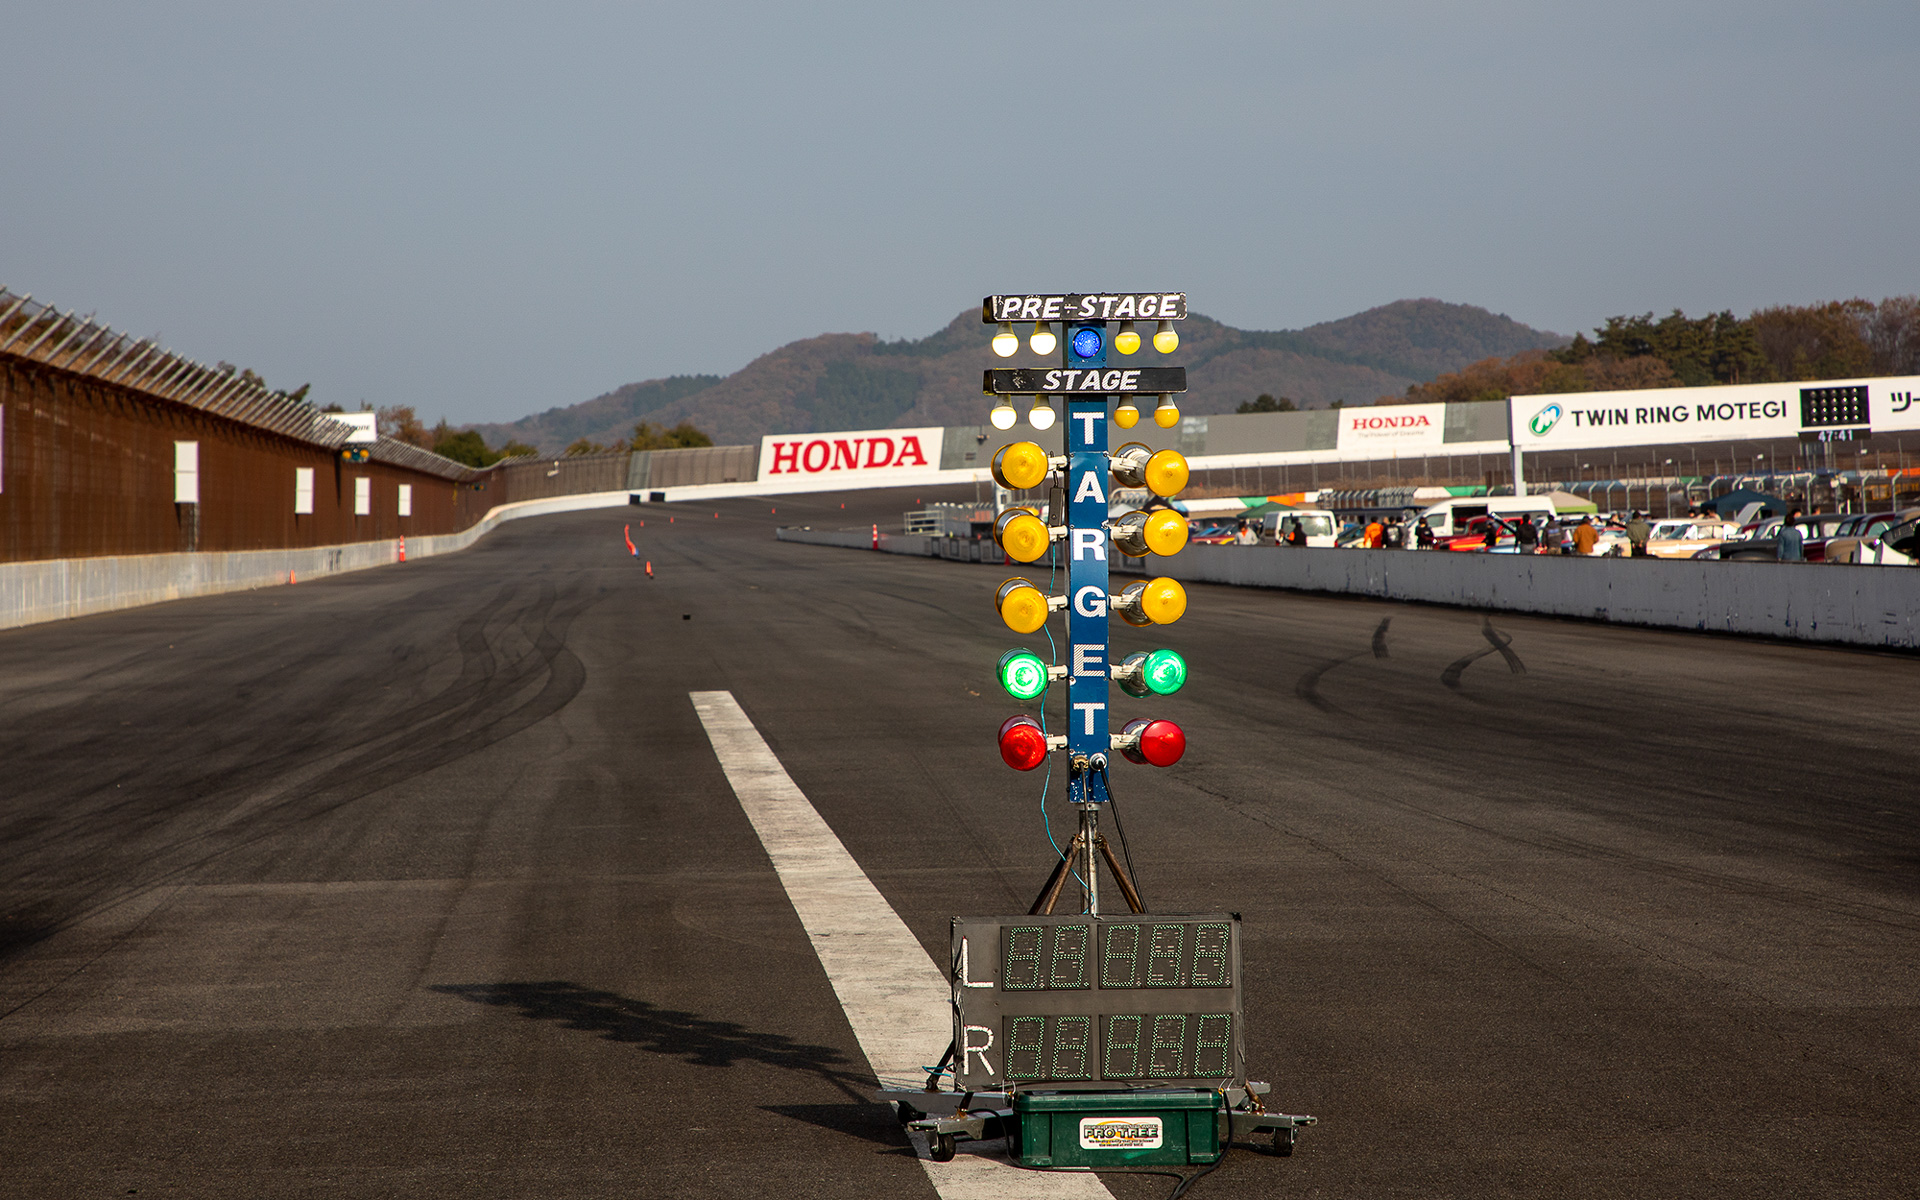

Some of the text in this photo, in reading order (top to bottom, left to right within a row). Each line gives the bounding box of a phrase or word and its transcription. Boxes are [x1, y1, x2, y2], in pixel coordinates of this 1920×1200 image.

[1001, 294, 1180, 319] PRE-STAGE
[1043, 370, 1141, 391] STAGE
[1352, 415, 1431, 430] HONDA
[1571, 400, 1787, 427] TWIN RING MOTEGI
[1818, 429, 1853, 442] 47:41
[769, 436, 928, 475] HONDA
[1072, 412, 1106, 736] TARGET
[962, 935, 994, 988] L
[963, 1024, 995, 1076] R
